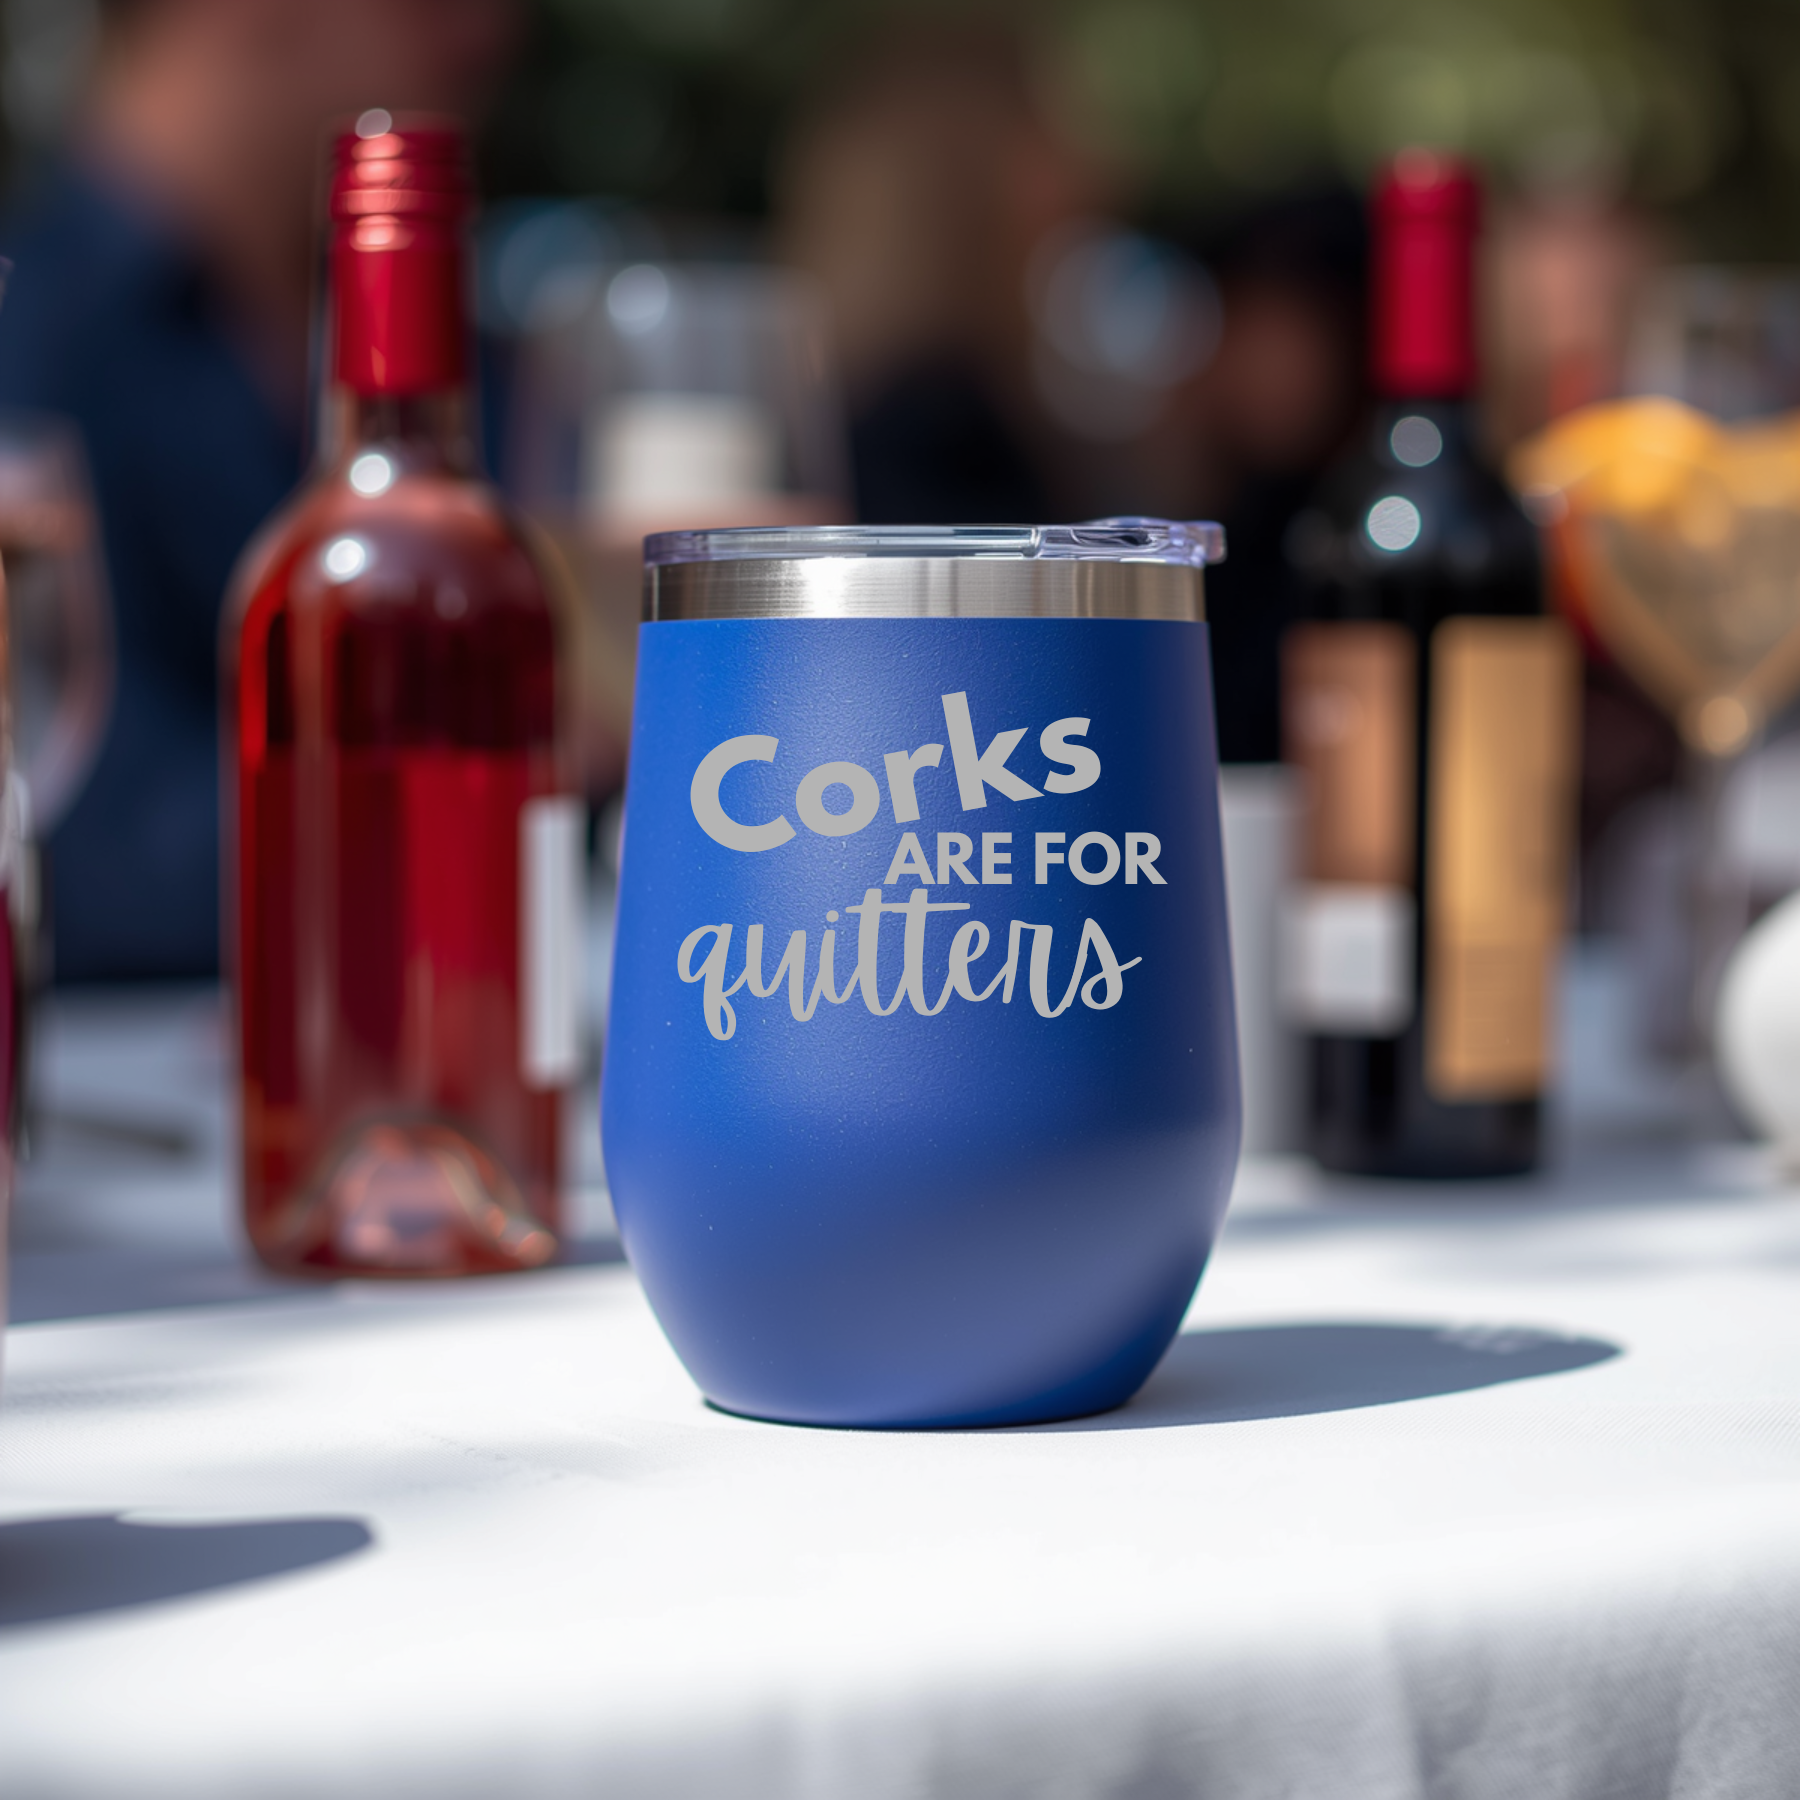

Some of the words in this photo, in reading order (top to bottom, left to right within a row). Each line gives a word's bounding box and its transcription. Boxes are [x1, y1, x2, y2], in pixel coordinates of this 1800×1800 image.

[690, 691, 1102, 853] Corks
[883, 832, 1013, 885] ARE
[1035, 831, 1168, 886] FOR
[677, 888, 1143, 1041] quitters
